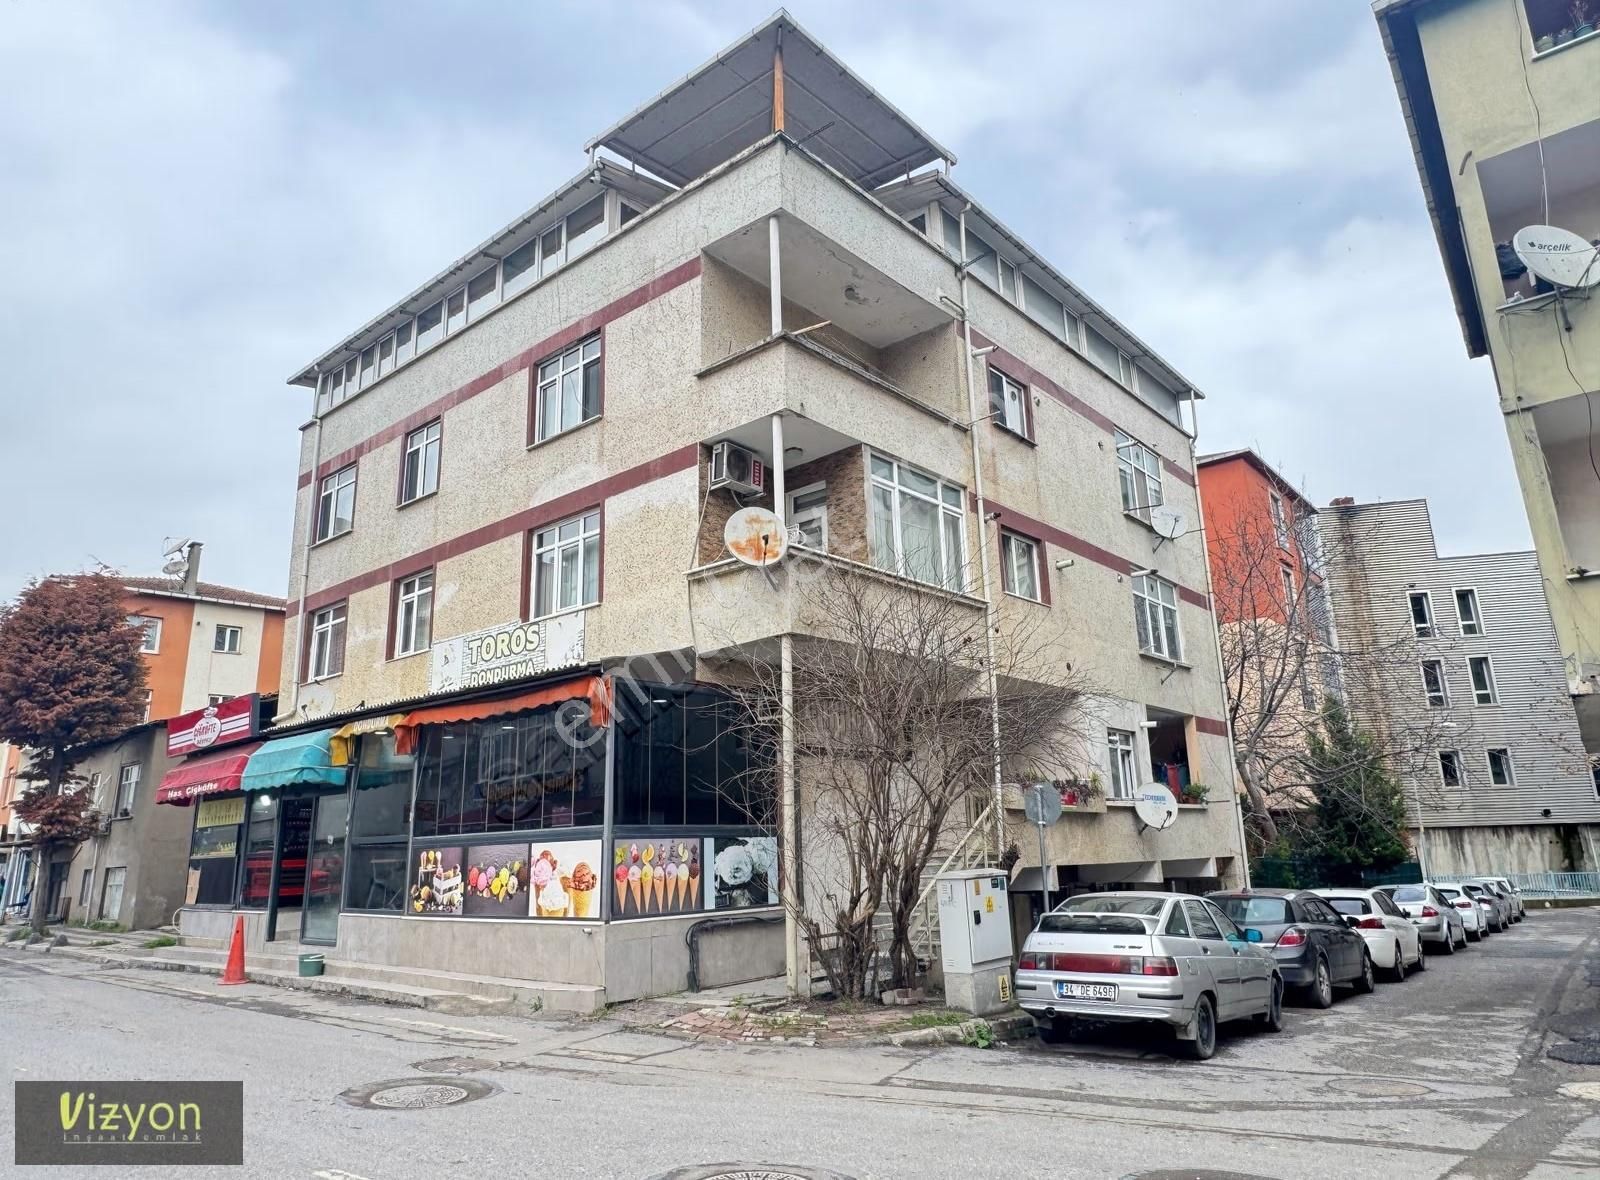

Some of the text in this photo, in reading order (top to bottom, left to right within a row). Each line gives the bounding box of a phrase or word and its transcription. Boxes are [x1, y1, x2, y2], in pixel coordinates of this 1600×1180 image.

[1537, 242, 1571, 252] arçelik
[467, 623, 541, 666] TOROS
[470, 658, 536, 686] DONDURMA
[1064, 984, 1113, 997] 34 DE 6496
